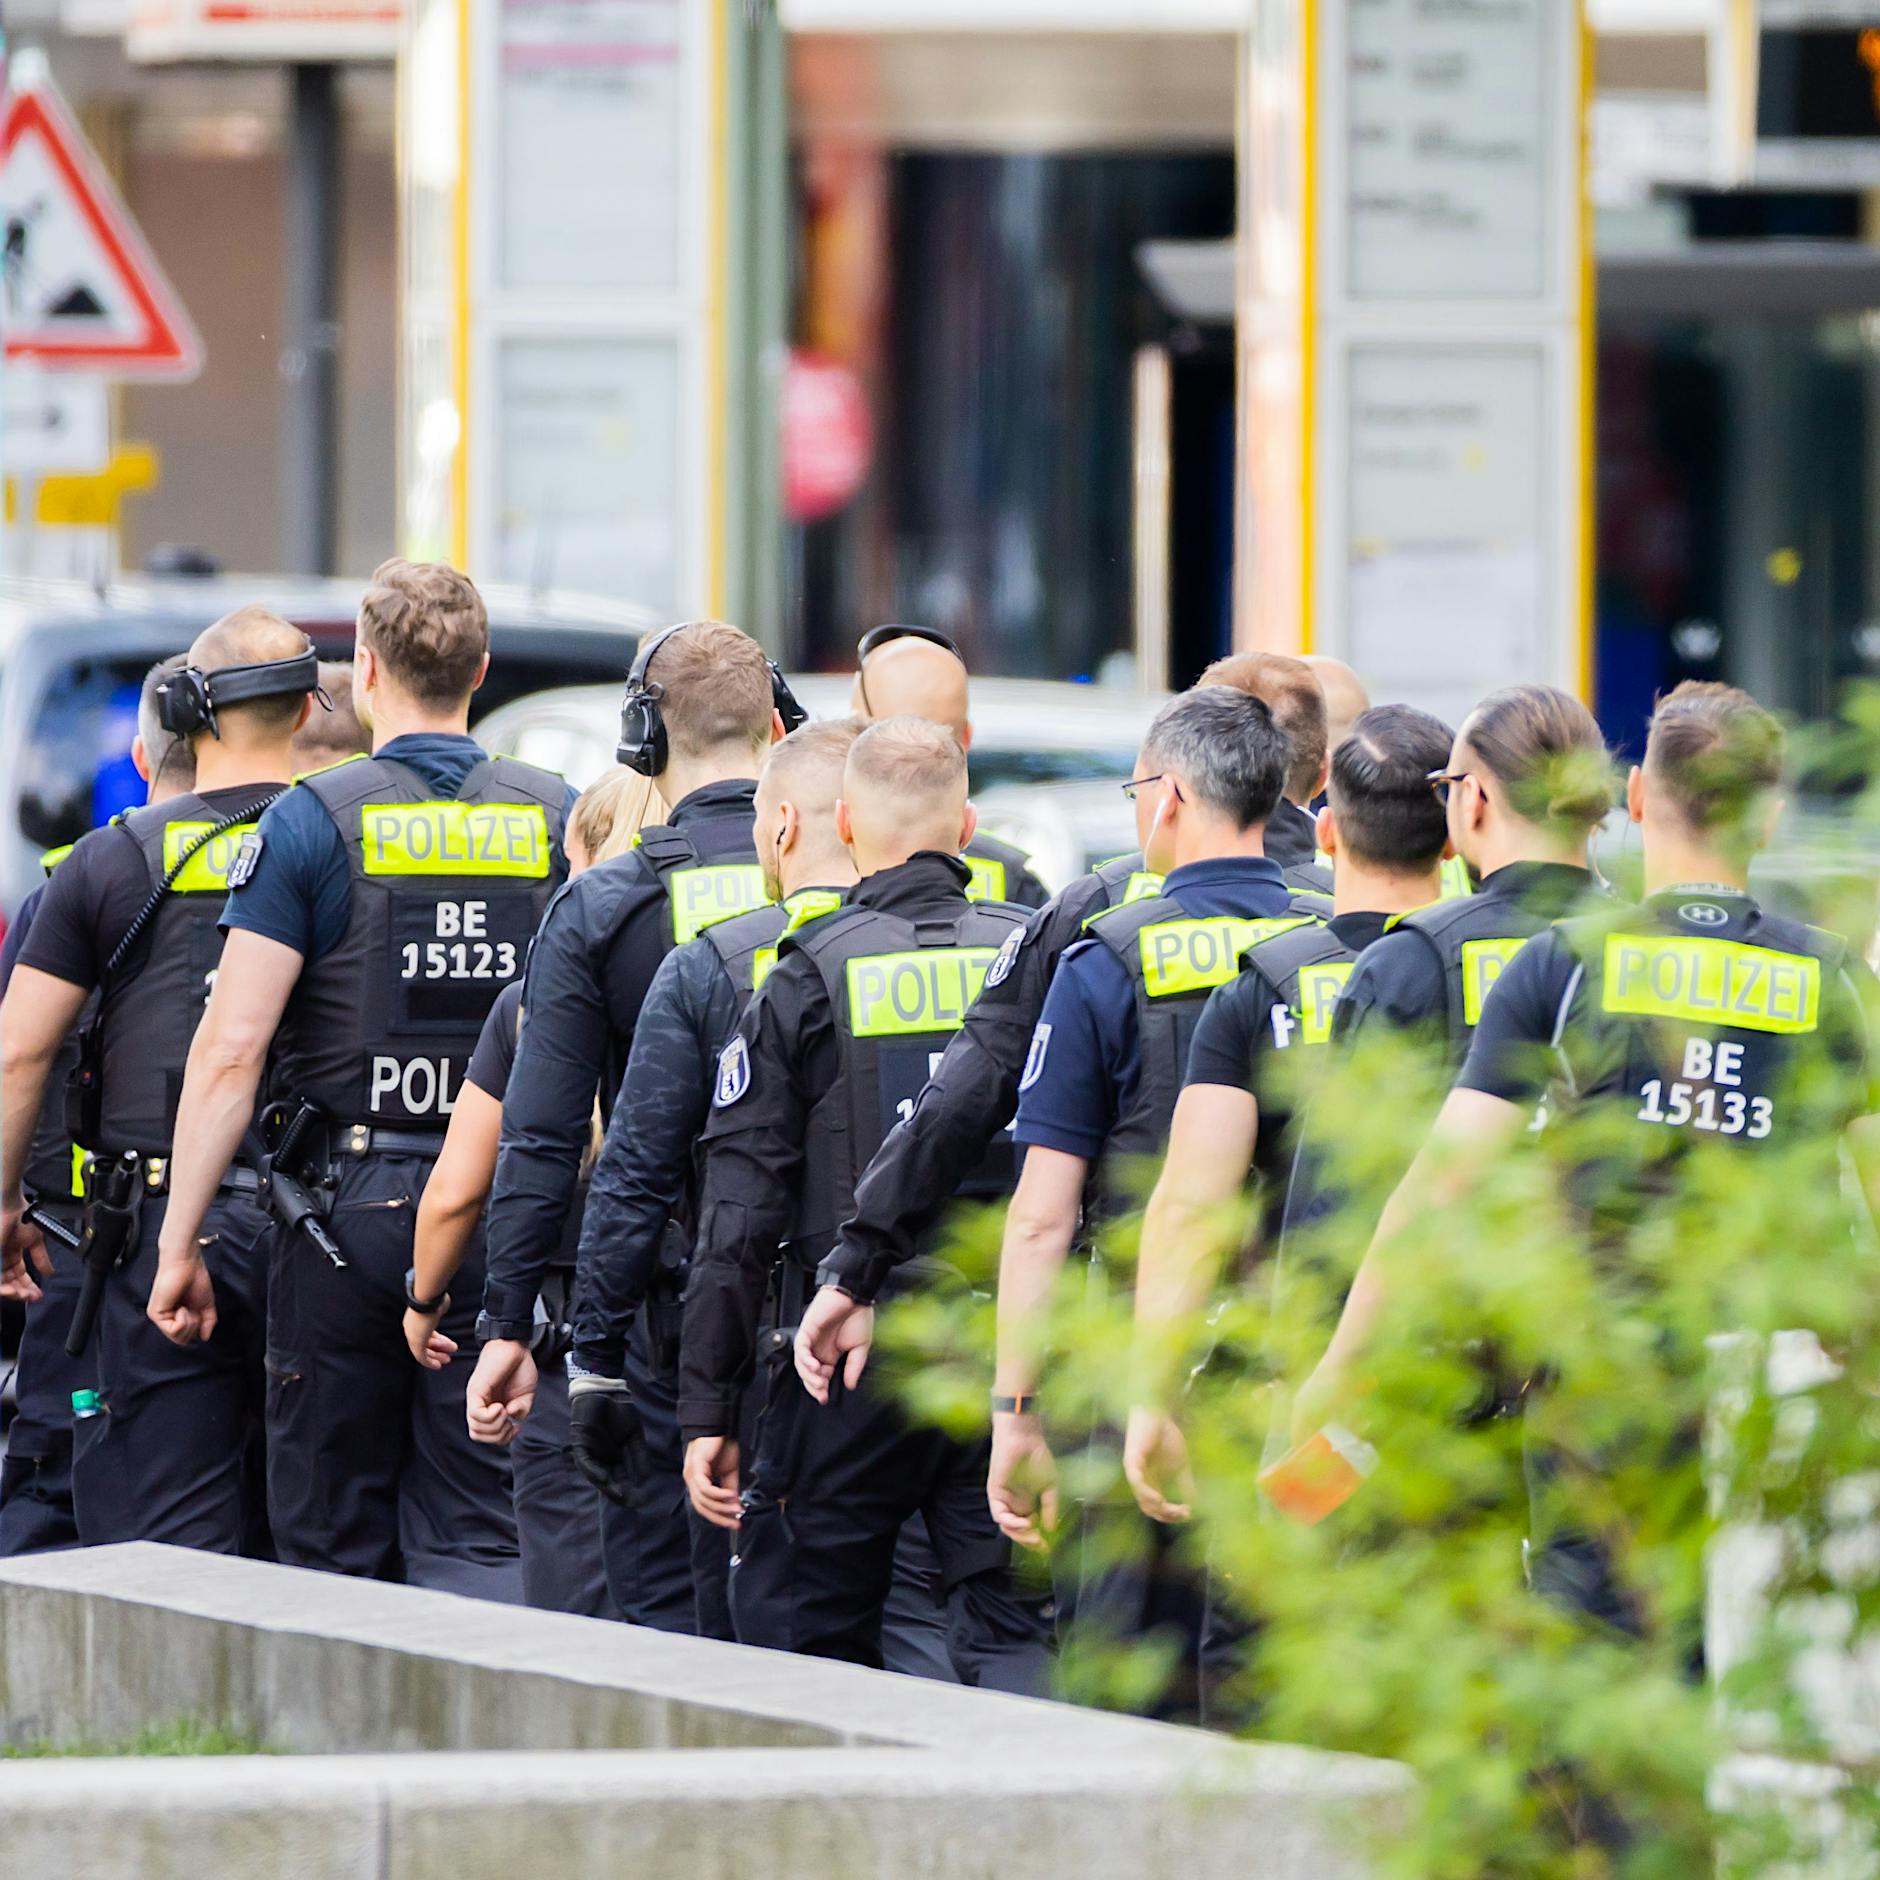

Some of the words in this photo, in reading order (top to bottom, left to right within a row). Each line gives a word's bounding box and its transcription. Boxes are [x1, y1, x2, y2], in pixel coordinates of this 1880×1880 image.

[376, 814, 538, 863] POLIZEI
[436, 901, 487, 937] BE
[401, 943, 516, 978] 15123
[1154, 927, 1278, 980] POL
[1617, 948, 1808, 1022] POLIZEI
[370, 1056, 472, 1114] POL
[1682, 1037, 1745, 1086] BE
[1637, 1079, 1773, 1138] 15133
